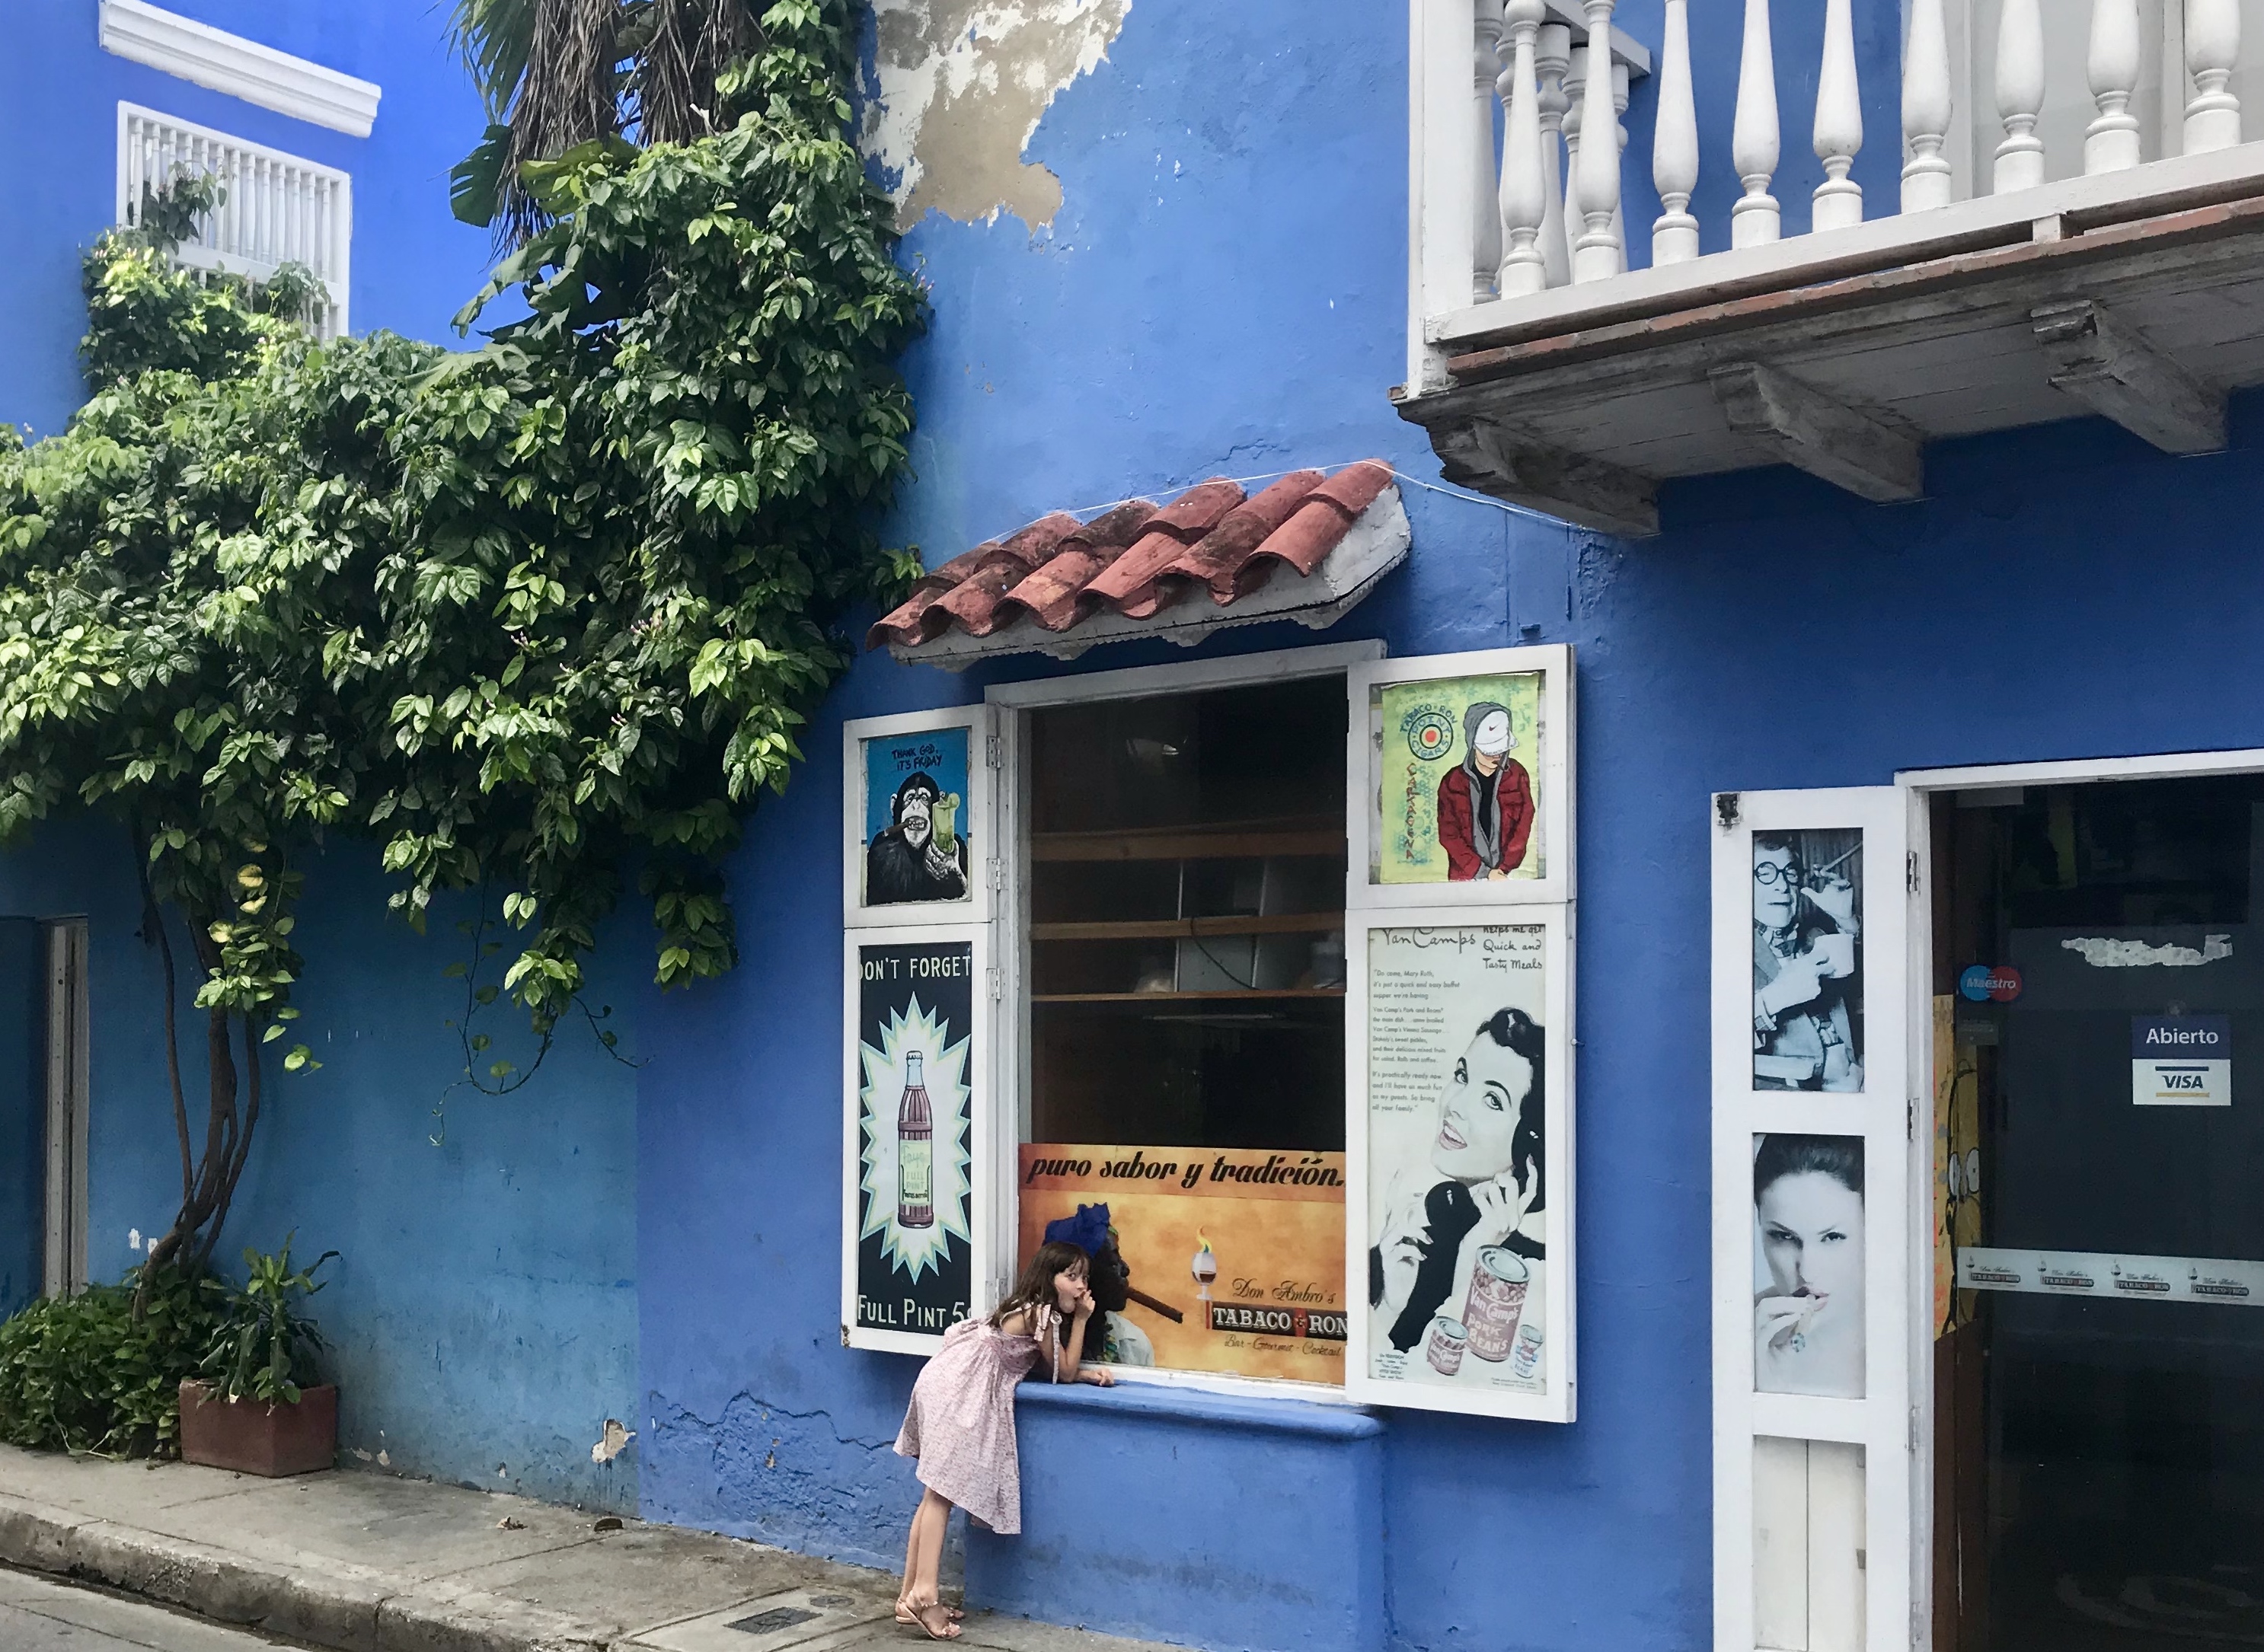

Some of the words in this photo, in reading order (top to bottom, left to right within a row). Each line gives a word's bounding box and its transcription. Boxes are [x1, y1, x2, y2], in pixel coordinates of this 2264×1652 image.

[892, 749, 916, 759] THANK
[1412, 739, 1449, 757] CIGARS
[914, 754, 942, 769] FRIDAY
[1483, 939, 1517, 953] Quick
[1522, 939, 1541, 950] and
[910, 955, 971, 978] FORGET
[1483, 958, 1507, 973] Tasty
[1510, 958, 1542, 969] Meals
[1966, 978, 2016, 990] Maestro
[2146, 1028, 2218, 1045] Abierto
[2163, 1075, 2203, 1089] VISA
[1026, 1157, 1092, 1185] puro
[1100, 1151, 1178, 1180] sabor
[1180, 1162, 1205, 1189] y
[1210, 1155, 1346, 1188] tradición.
[1232, 1278, 1264, 1298] Don
[1272, 1280, 1336, 1304] Ambro's
[857, 1294, 897, 1325] FULL
[904, 1298, 947, 1328] PINT
[1213, 1307, 1291, 1330] TABACO
[1308, 1315, 1348, 1335] RON
[1225, 1334, 1244, 1347] Bar
